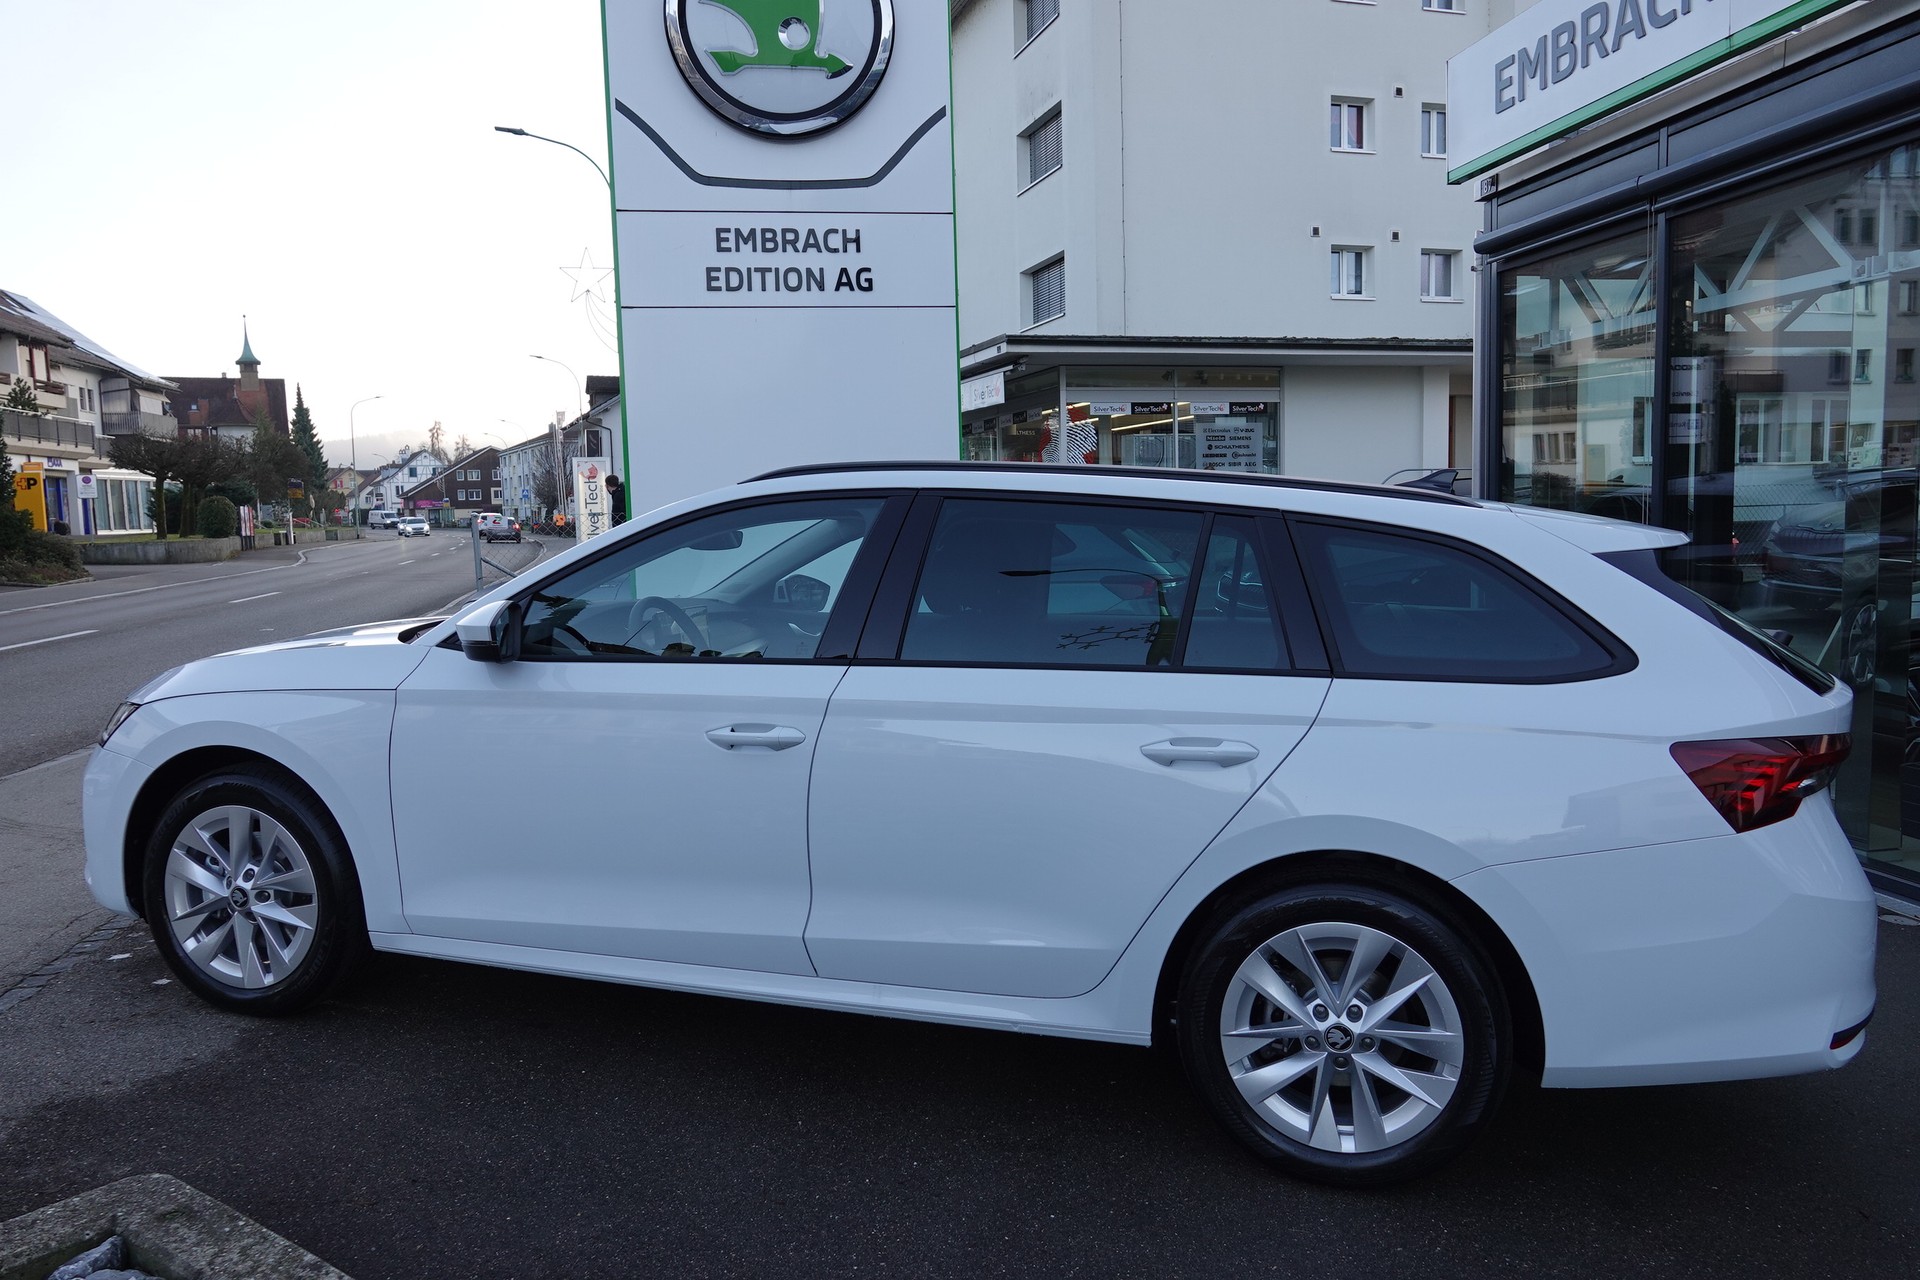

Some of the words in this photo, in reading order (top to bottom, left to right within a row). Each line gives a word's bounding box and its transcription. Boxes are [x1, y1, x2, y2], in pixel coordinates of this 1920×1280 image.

[1495, 0, 1712, 114] EMBRAC
[715, 228, 861, 253] EMBRACH
[706, 267, 825, 292] EDITION
[834, 267, 873, 292] AG
